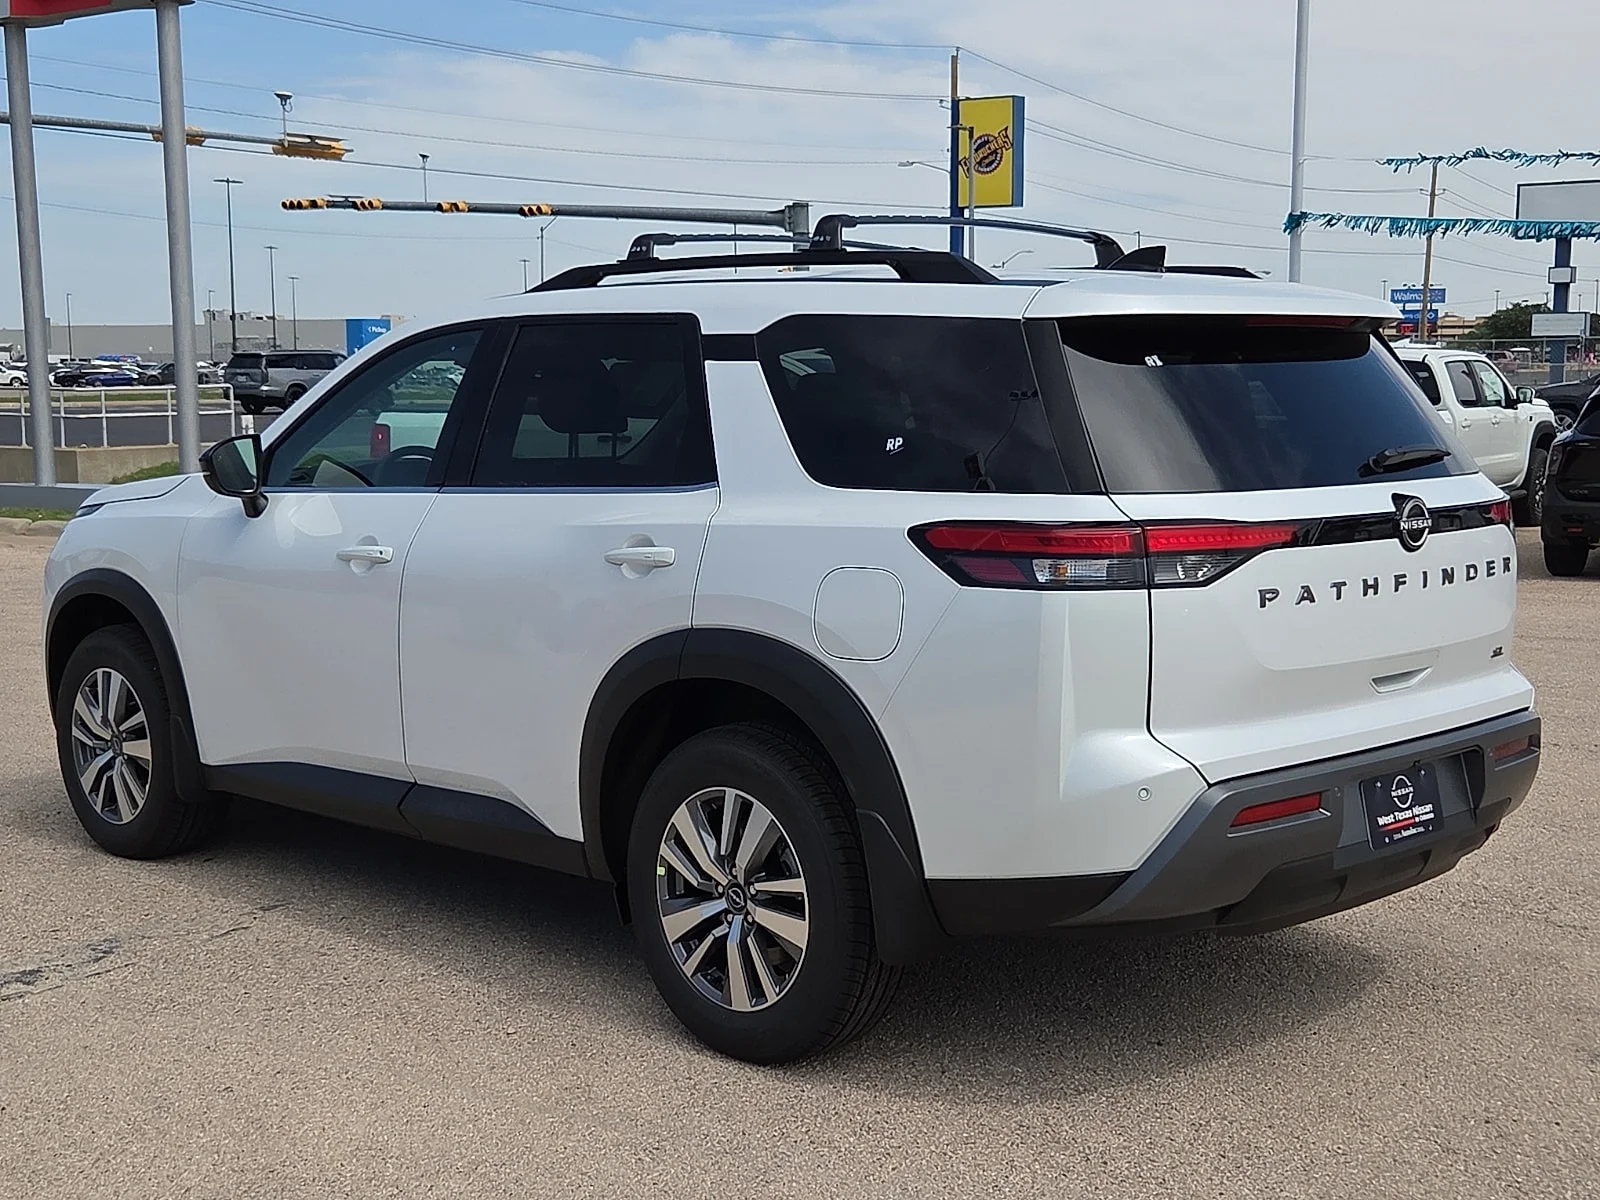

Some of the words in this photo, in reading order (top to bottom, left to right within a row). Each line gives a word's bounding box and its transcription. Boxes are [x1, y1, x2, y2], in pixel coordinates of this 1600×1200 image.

[1393, 291, 1431, 301] Walma
[886, 437, 904, 451] RP
[1400, 519, 1432, 530] NISSAN
[1257, 555, 1512, 609] PATHFINDER
